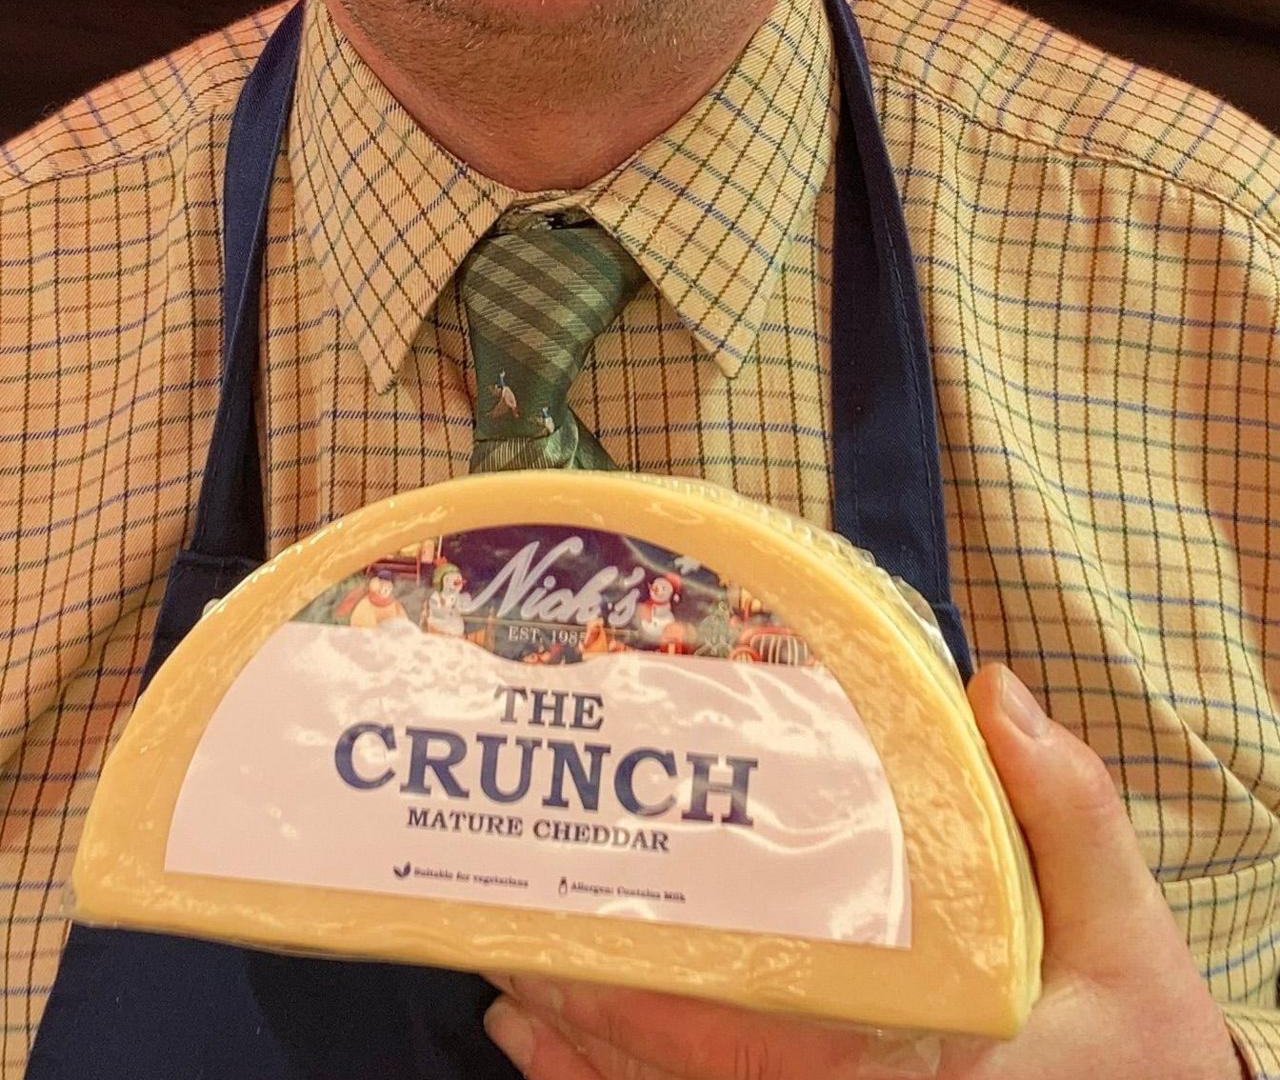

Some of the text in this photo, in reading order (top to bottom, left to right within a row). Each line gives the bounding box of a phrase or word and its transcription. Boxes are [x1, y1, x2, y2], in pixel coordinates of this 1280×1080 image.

[460, 535, 646, 627] Nick's
[508, 624, 545, 643] EST.
[494, 685, 605, 732] THE
[334, 720, 759, 827] CRUNCH
[406, 806, 670, 854] MATURE CHEDDAR
